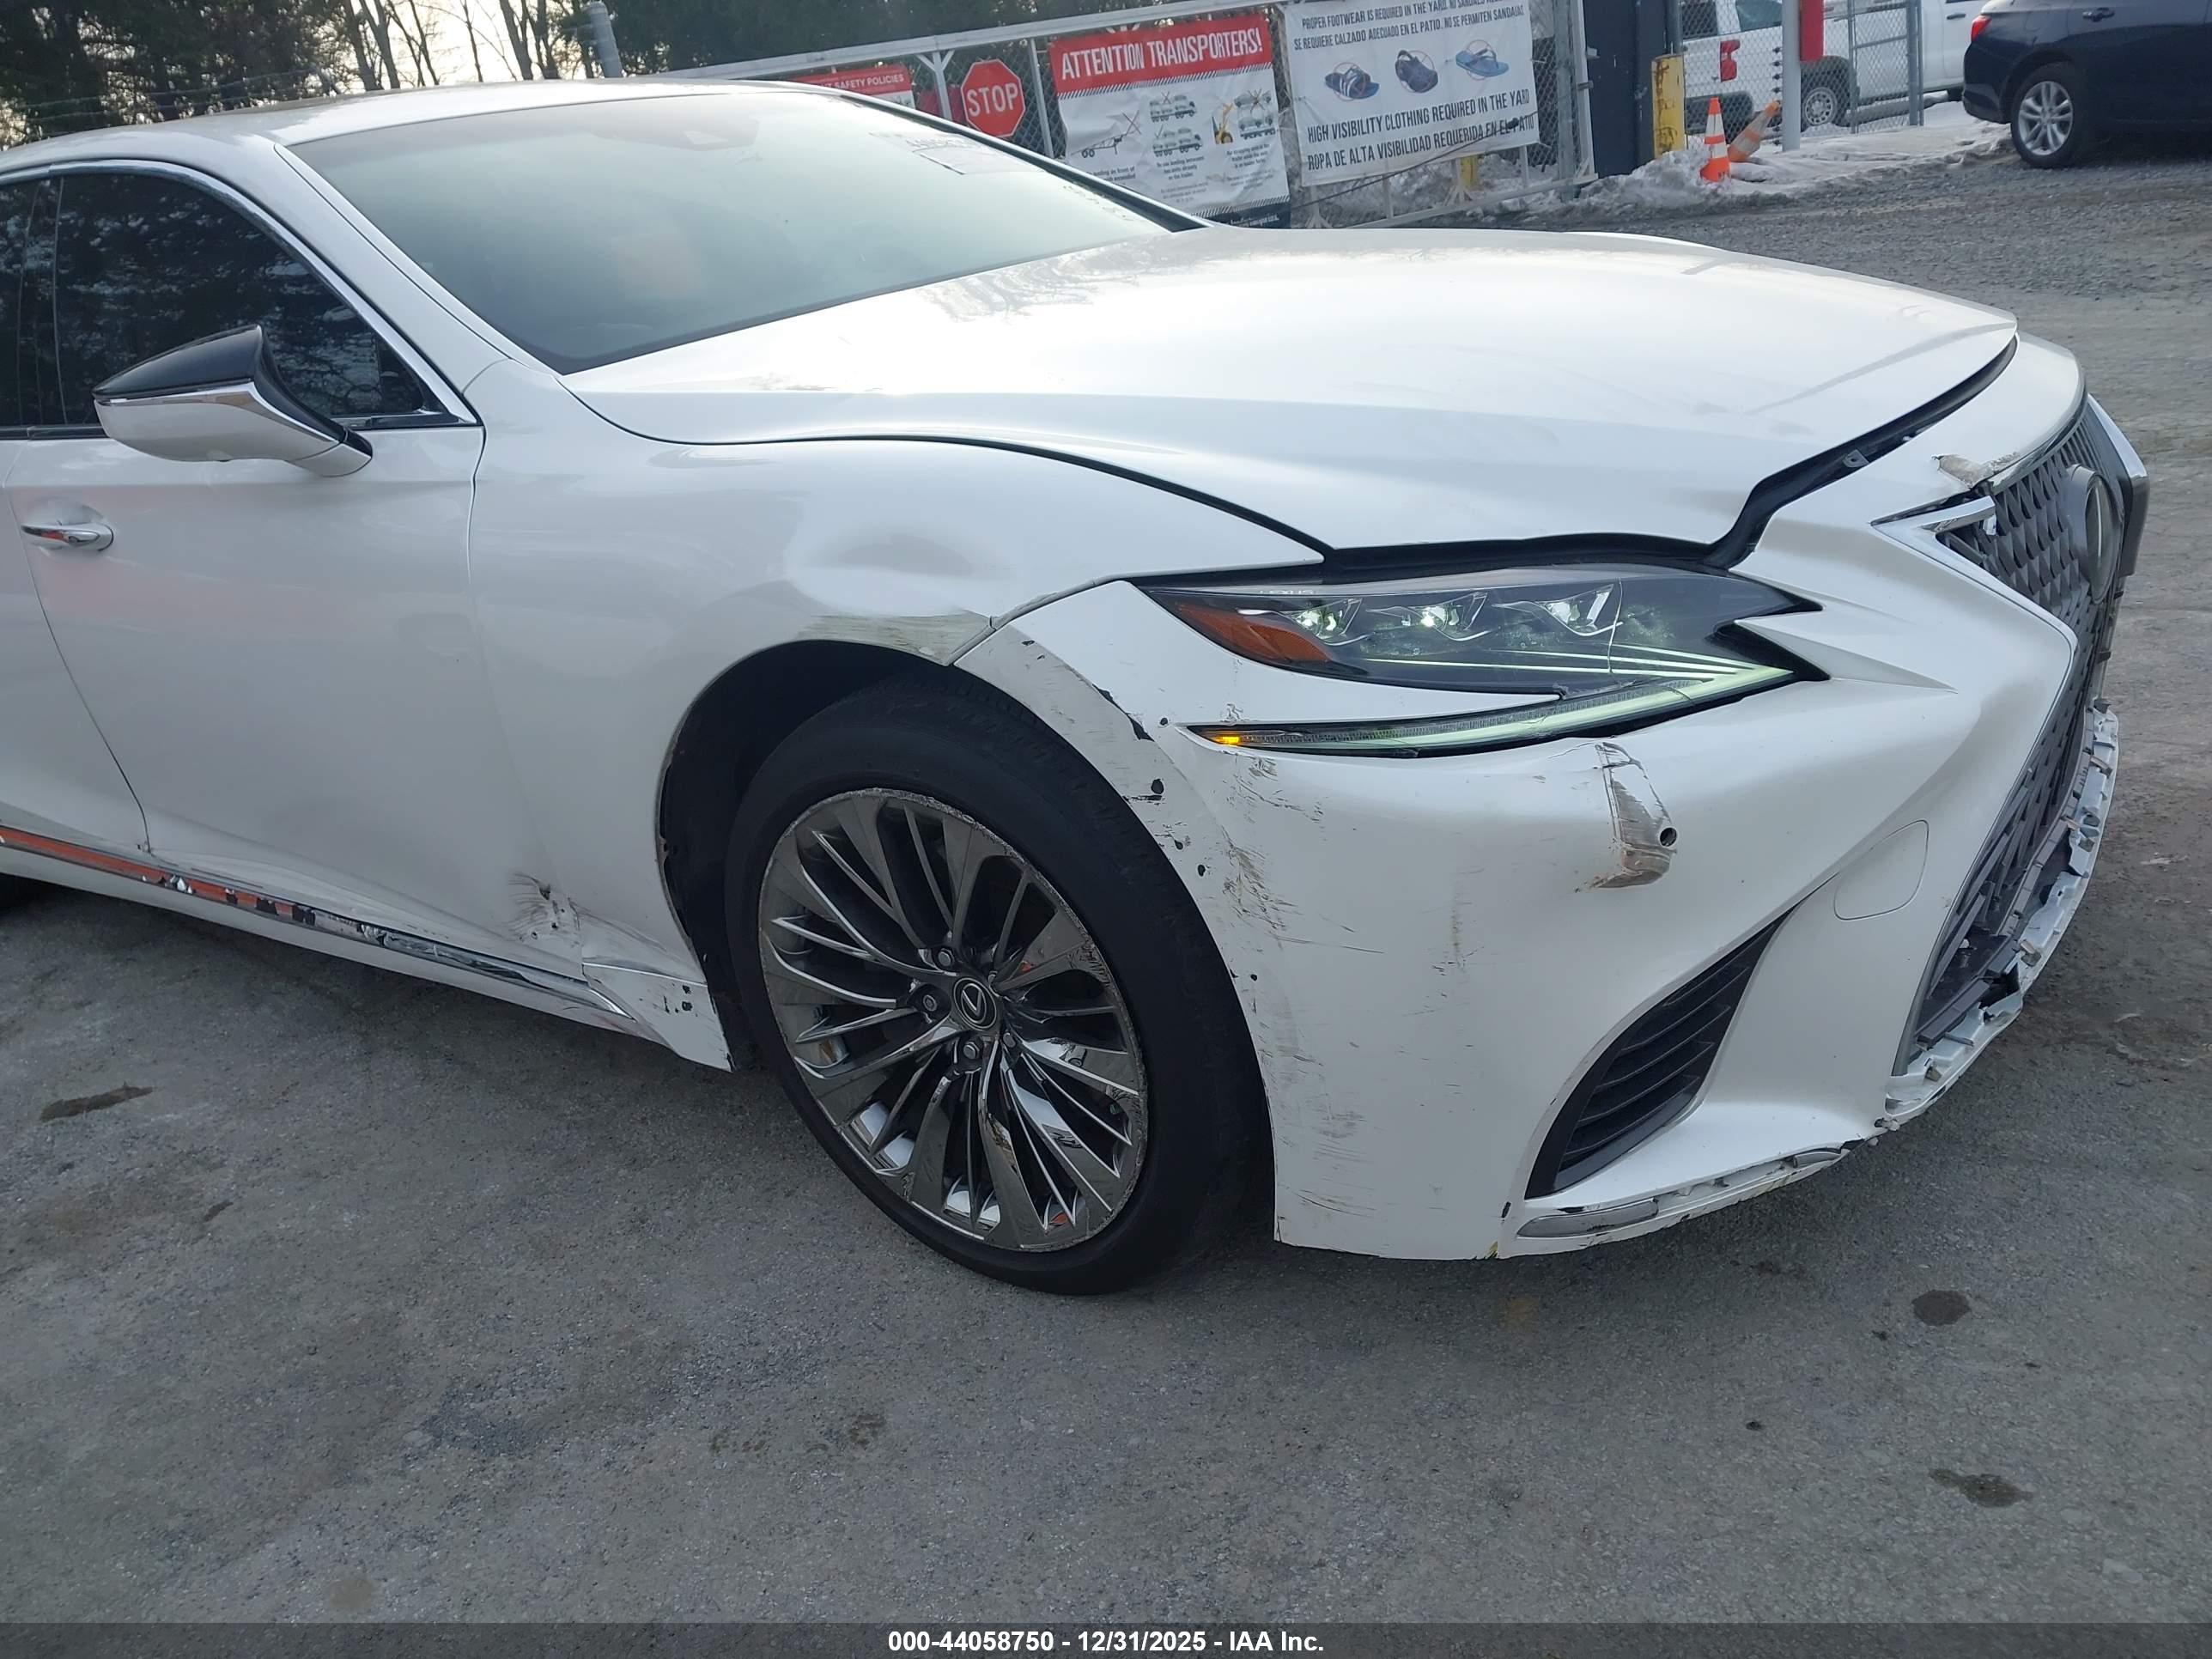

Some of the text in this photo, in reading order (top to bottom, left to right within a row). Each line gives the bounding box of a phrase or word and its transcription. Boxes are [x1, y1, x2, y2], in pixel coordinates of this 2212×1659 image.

[1293, 39, 1303, 51] SE
[1303, 35, 1334, 49] REQUIERE
[1334, 30, 1366, 45] CALZADO
[1368, 25, 1399, 40] ADECUADO
[1401, 24, 1409, 35] EN
[1411, 23, 1419, 34] EL
[1444, 16, 1452, 28] NO
[1453, 15, 1460, 27] SE
[1461, 10, 1492, 26] PERMITEN
[1302, 16, 1327, 30] PROPER
[1328, 9, 1365, 27] FOOTWEAR
[1367, 9, 1374, 21] IS
[1374, 5, 1402, 21] REQUIRED
[1404, 3, 1412, 16] IN
[1413, 3, 1426, 15] THE
[1061, 27, 1263, 80] ATTENTION TRANSPORTERS!
[835, 74, 904, 89] SAFETY POLICIES
[967, 82, 1018, 117] STOP
[1307, 88, 1529, 143] HIGH VISIBILITY CLOTHING REQUIRED IN THE YARD
[1307, 151, 1333, 171] ROPA
[1334, 149, 1347, 167] DE
[1349, 145, 1376, 165] ALTA
[1376, 135, 1431, 159] VISIBILIDAD
[1433, 124, 1484, 149] REQUERIDA
[1486, 120, 1497, 137] EN
